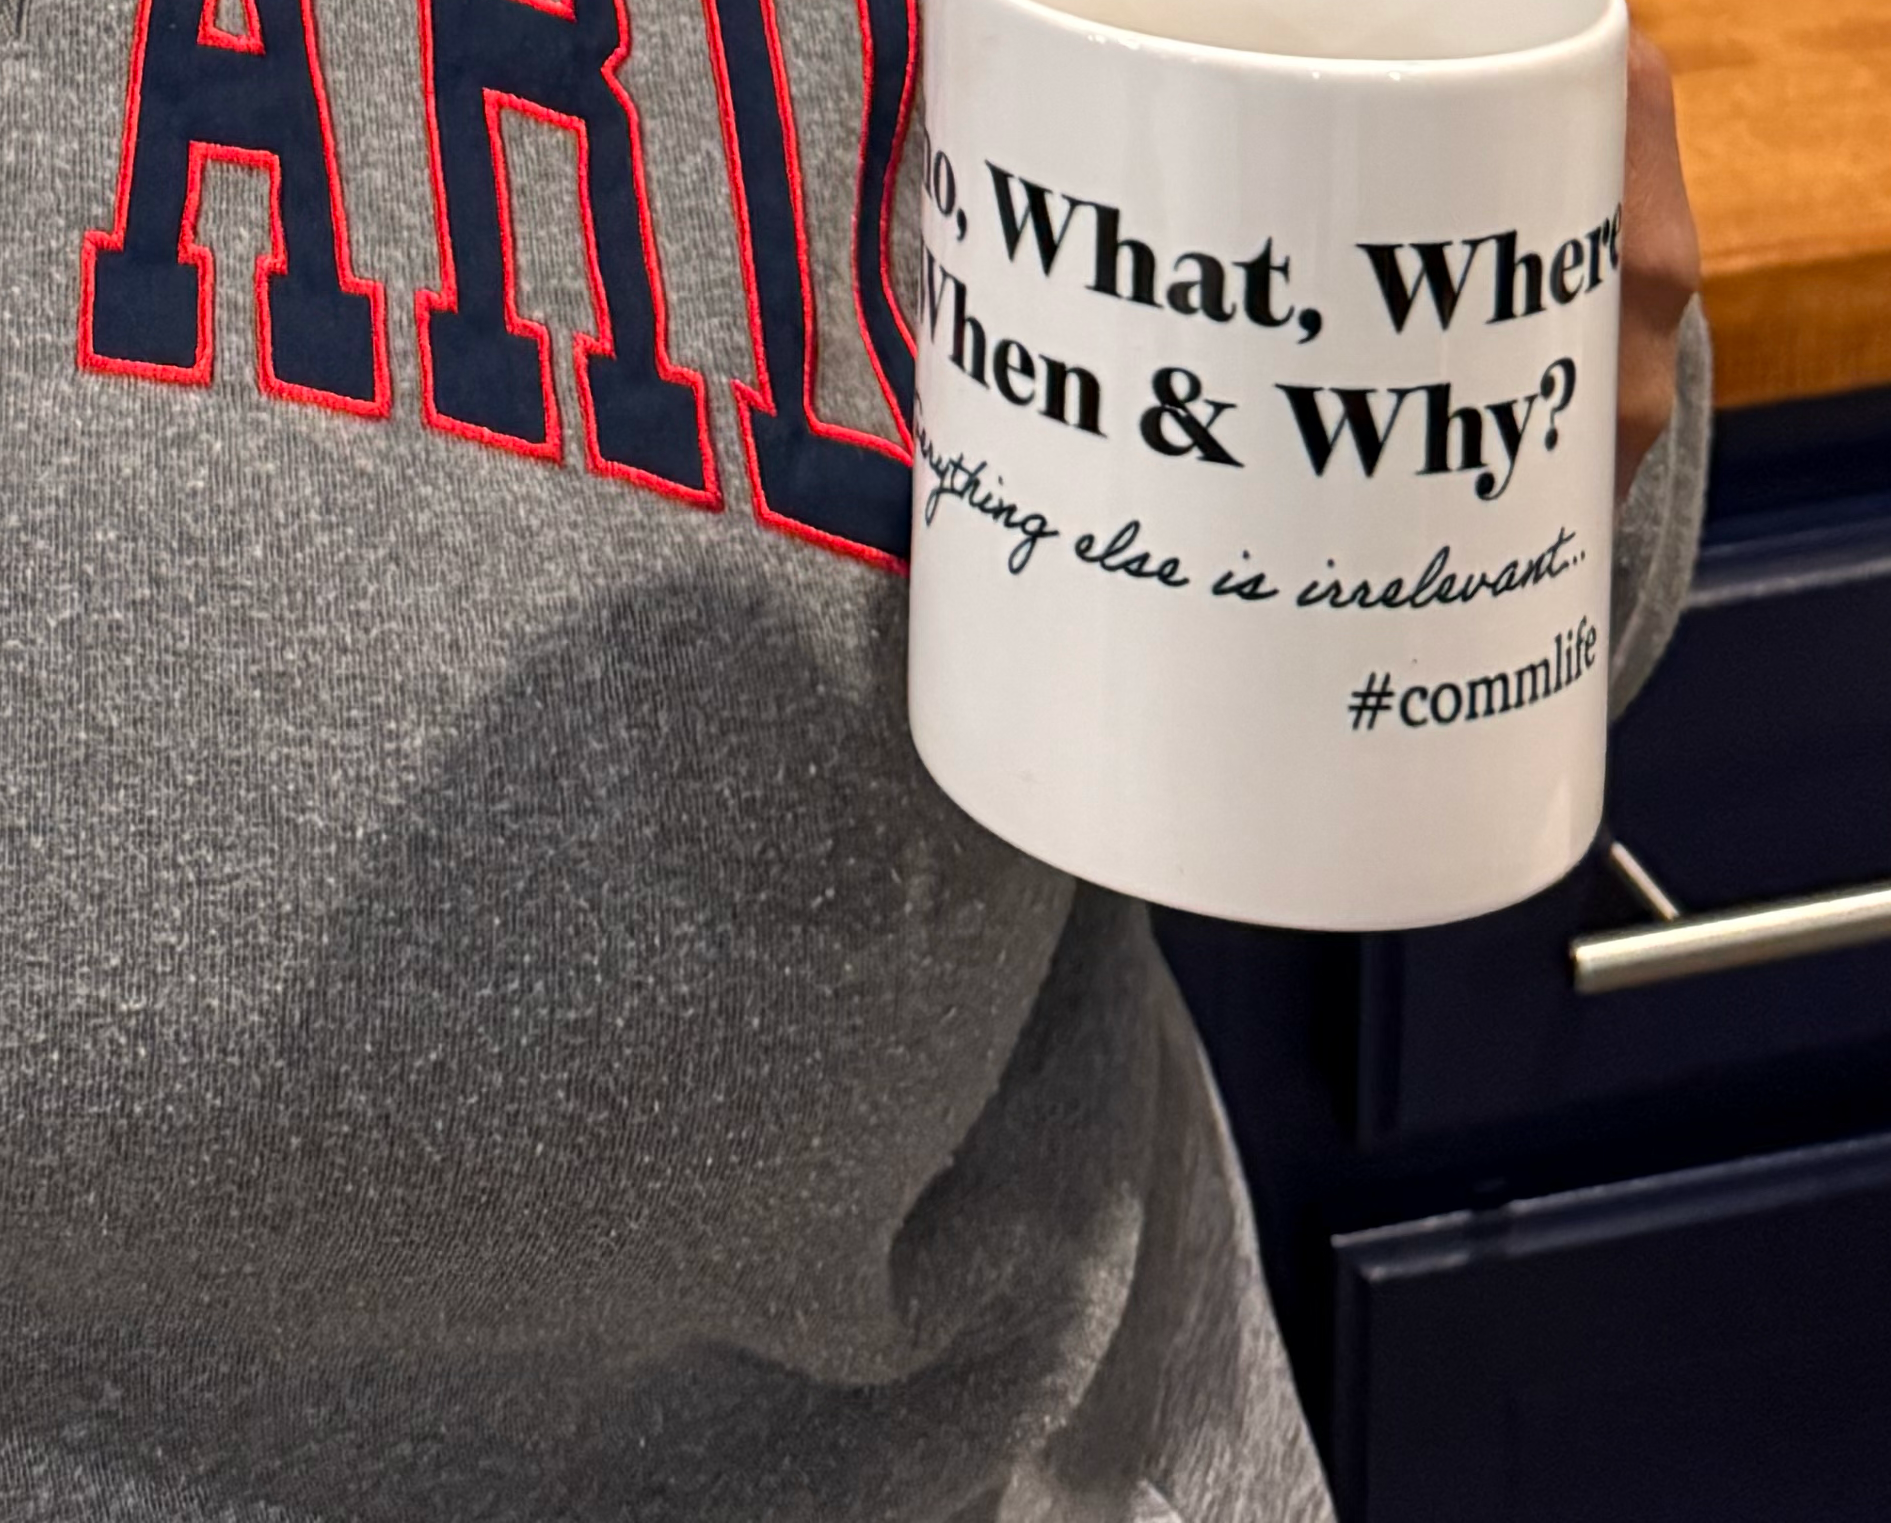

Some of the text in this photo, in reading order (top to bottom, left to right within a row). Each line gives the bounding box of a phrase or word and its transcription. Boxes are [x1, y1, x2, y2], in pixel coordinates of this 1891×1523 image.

[984, 158, 1325, 345] What,
[1355, 201, 1622, 334] Where
[1138, 365, 1246, 470] &
[1274, 356, 1577, 501] Why?
[1074, 520, 1190, 588] else
[1211, 549, 1280, 603] is
[1348, 615, 1598, 731] #commlife
